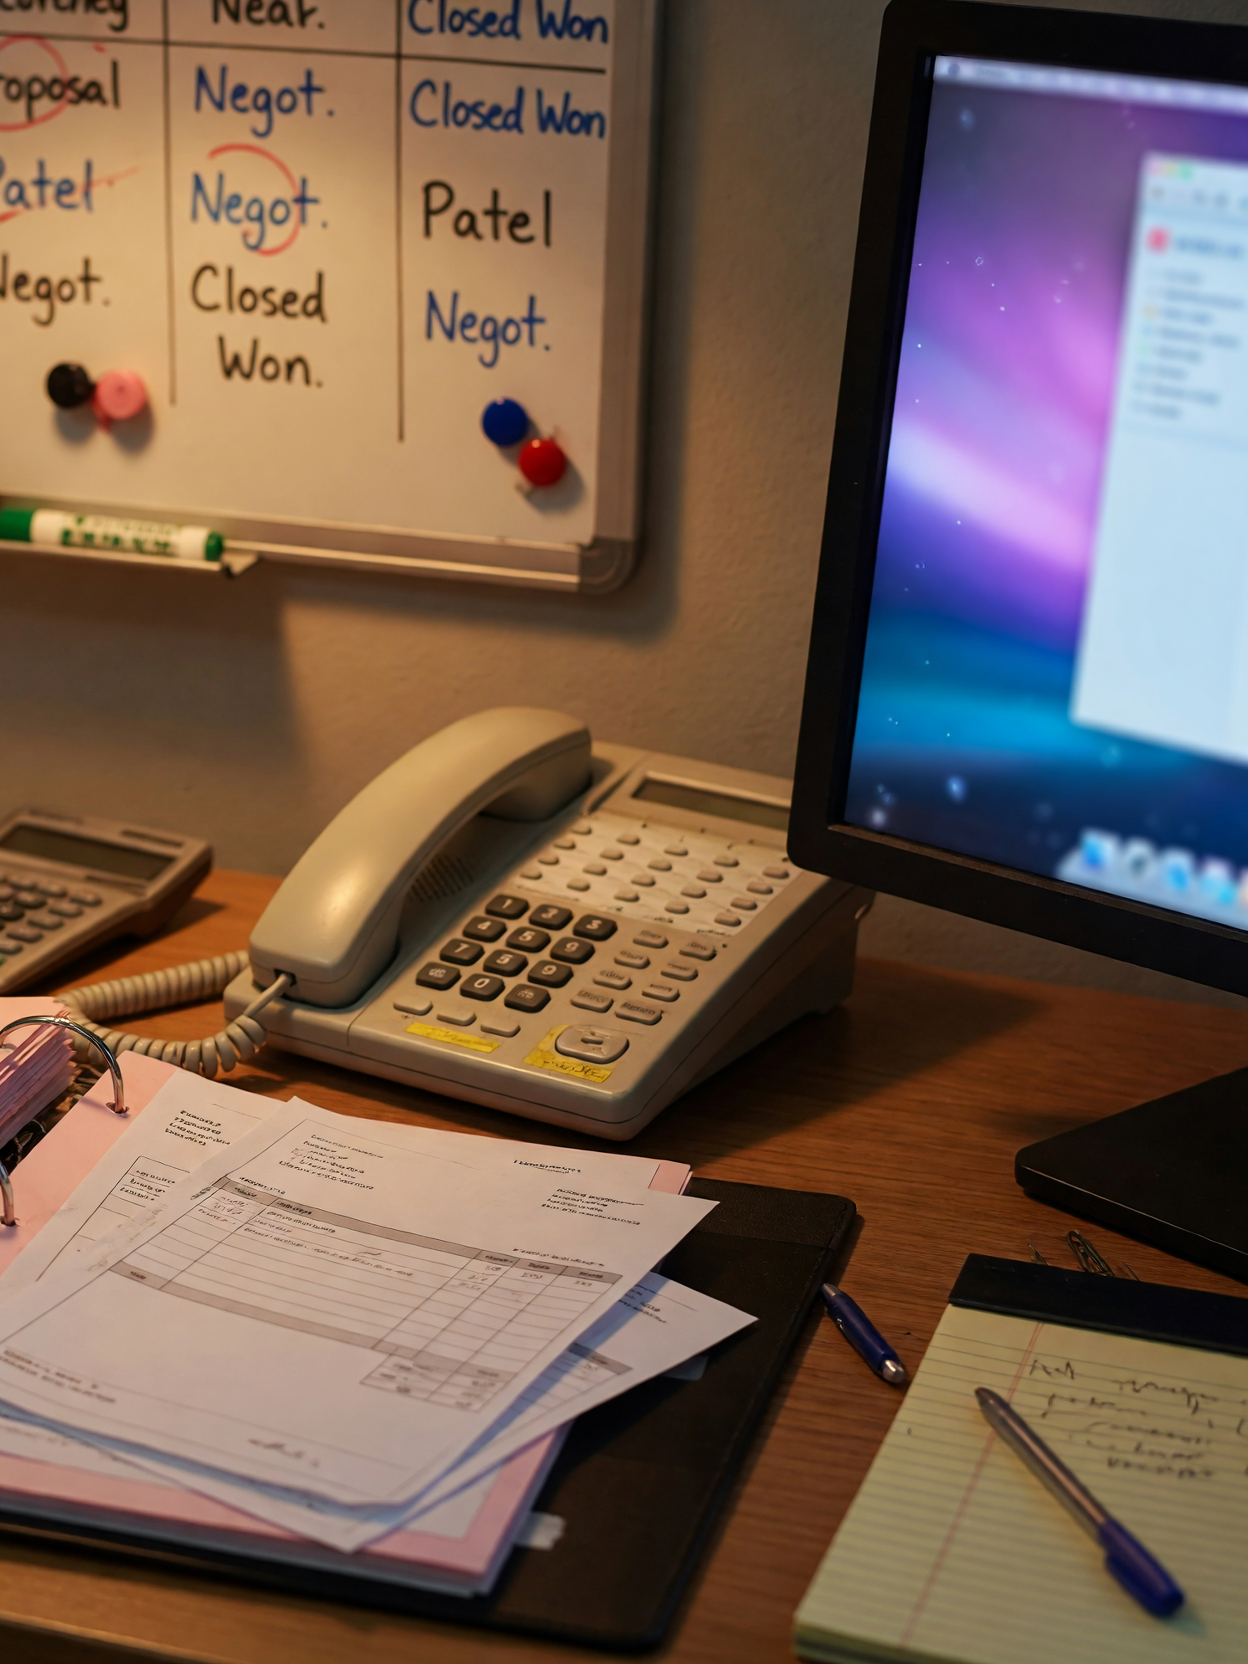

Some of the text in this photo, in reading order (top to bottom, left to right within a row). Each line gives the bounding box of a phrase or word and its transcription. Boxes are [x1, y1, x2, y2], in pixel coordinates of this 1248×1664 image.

[408, 0, 609, 43] Closed Won
[194, 64, 335, 138] Negot.
[409, 80, 606, 139] Closed Won
[191, 171, 328, 251] Negot.
[421, 180, 552, 248] Patel
[191, 265, 327, 323] Closed
[425, 290, 551, 368] Negot.
[217, 335, 324, 388] Won.
[473, 977, 491, 989] 0
